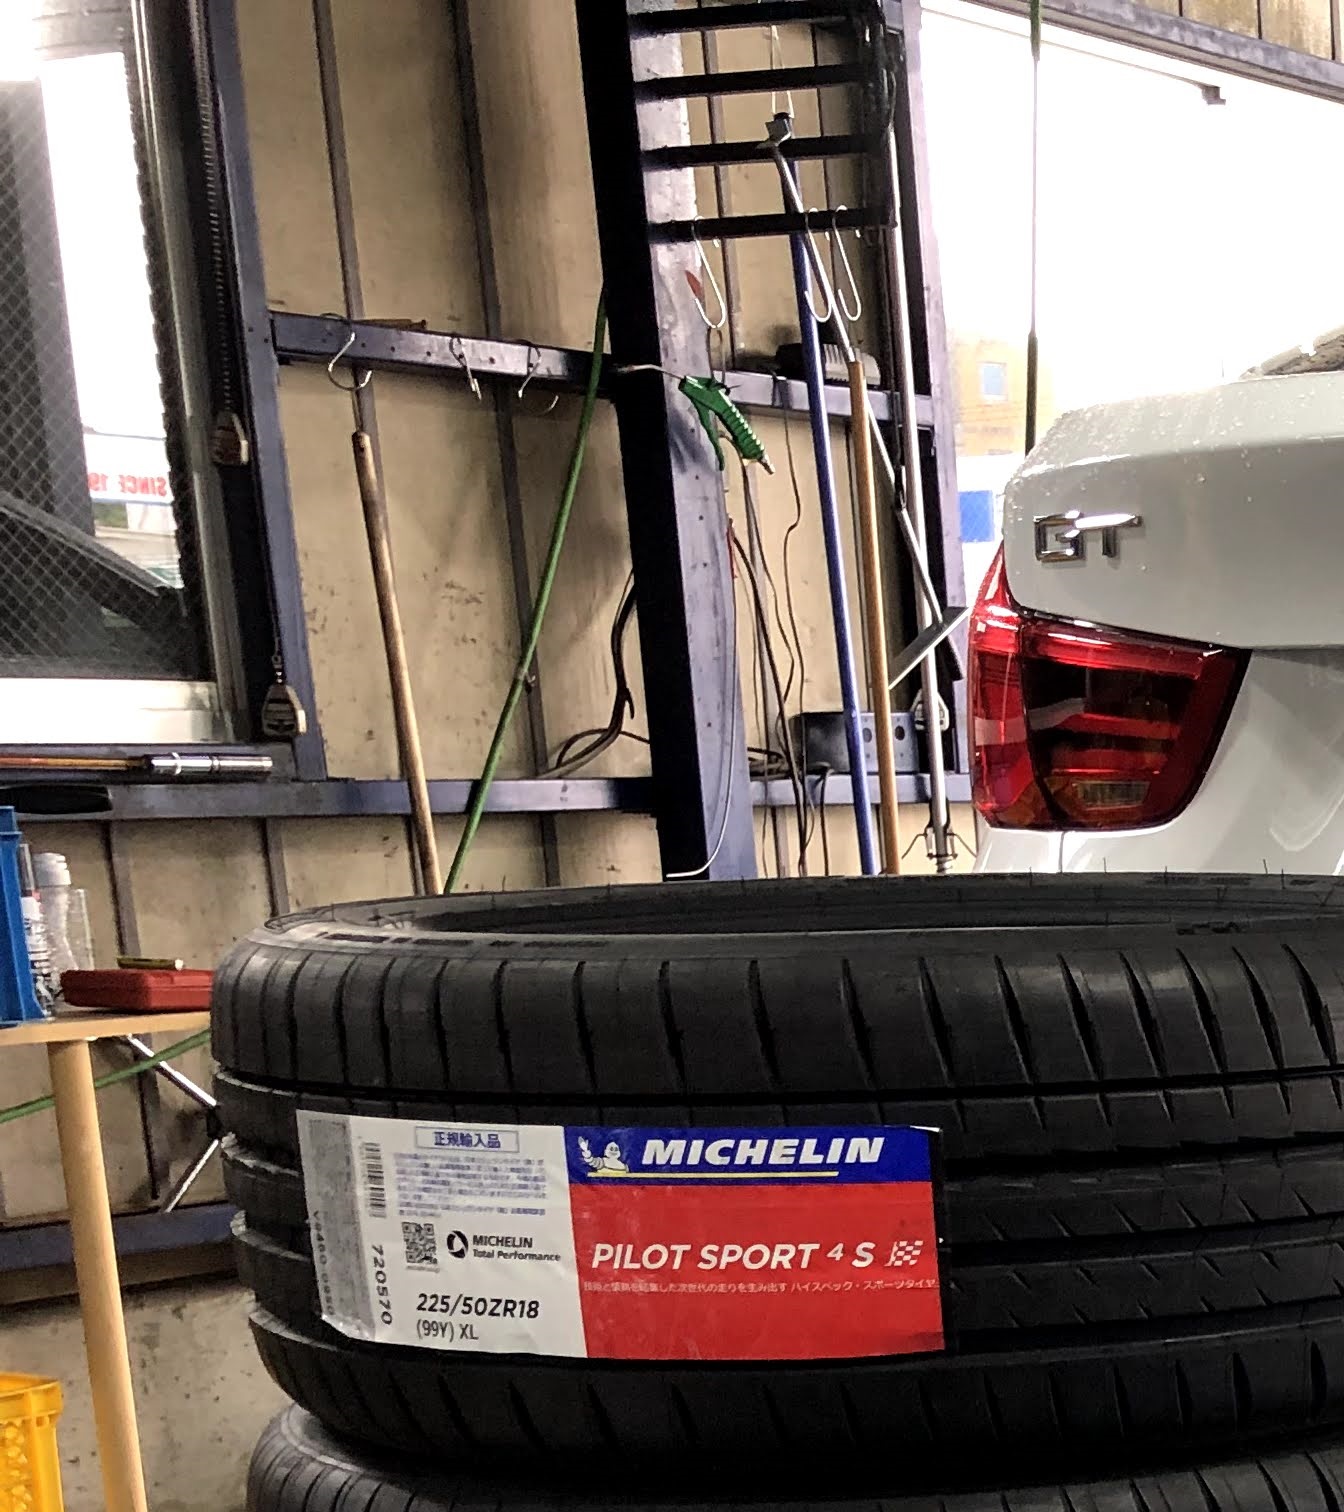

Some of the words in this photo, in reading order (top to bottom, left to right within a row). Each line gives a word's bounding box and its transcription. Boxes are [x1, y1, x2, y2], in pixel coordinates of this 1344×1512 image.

[1033, 510, 1141, 562] GT
[434, 1131, 500, 1150] 正規輸入品
[641, 1137, 885, 1164] MICHELIN
[472, 1235, 533, 1248] MICHELIN
[472, 1249, 496, 1258] Total
[498, 1251, 561, 1262] Performance
[592, 1243, 692, 1269] PILOT
[697, 1242, 819, 1270] SPORT
[827, 1243, 843, 1260] 4
[852, 1244, 874, 1267] S
[371, 1244, 393, 1325] 720570
[417, 1294, 539, 1320] 225/50ZR18
[417, 1320, 454, 1341] (99Y)
[459, 1322, 479, 1341] XL
